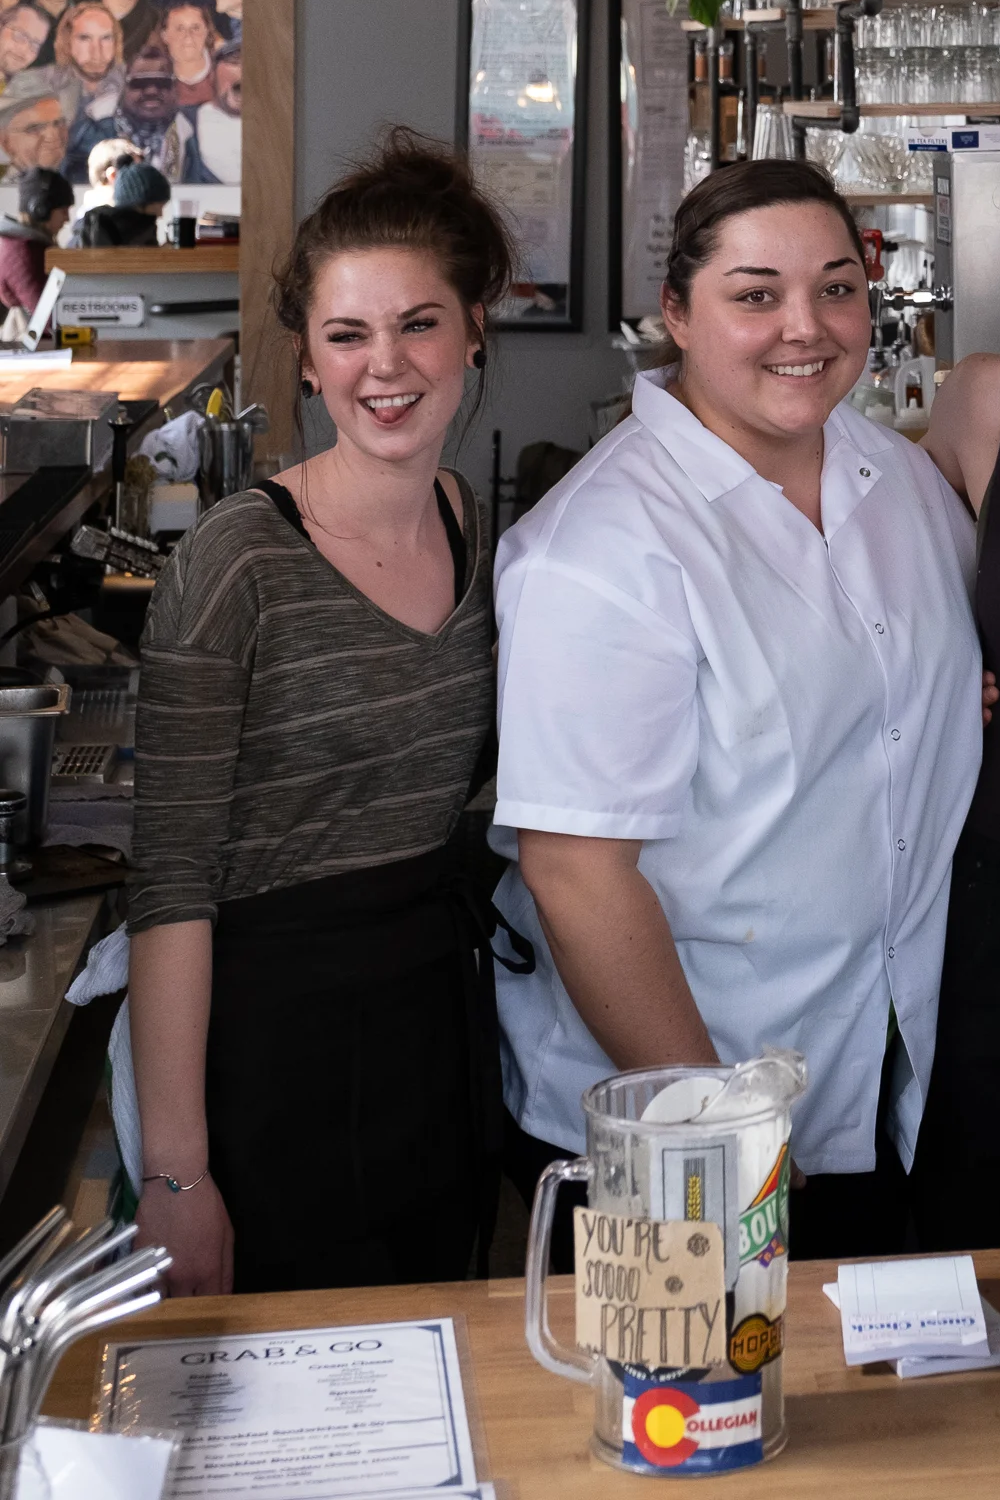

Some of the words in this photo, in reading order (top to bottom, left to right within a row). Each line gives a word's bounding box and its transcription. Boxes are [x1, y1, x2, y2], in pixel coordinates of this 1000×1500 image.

[62, 303, 138, 313] RESTROOMS
[581, 1213, 670, 1274] YOU'RE
[180, 1349, 285, 1366] GRAB
[295, 1344, 317, 1357] &
[330, 1339, 383, 1353] GO
[600, 1298, 721, 1366] PRETTY
